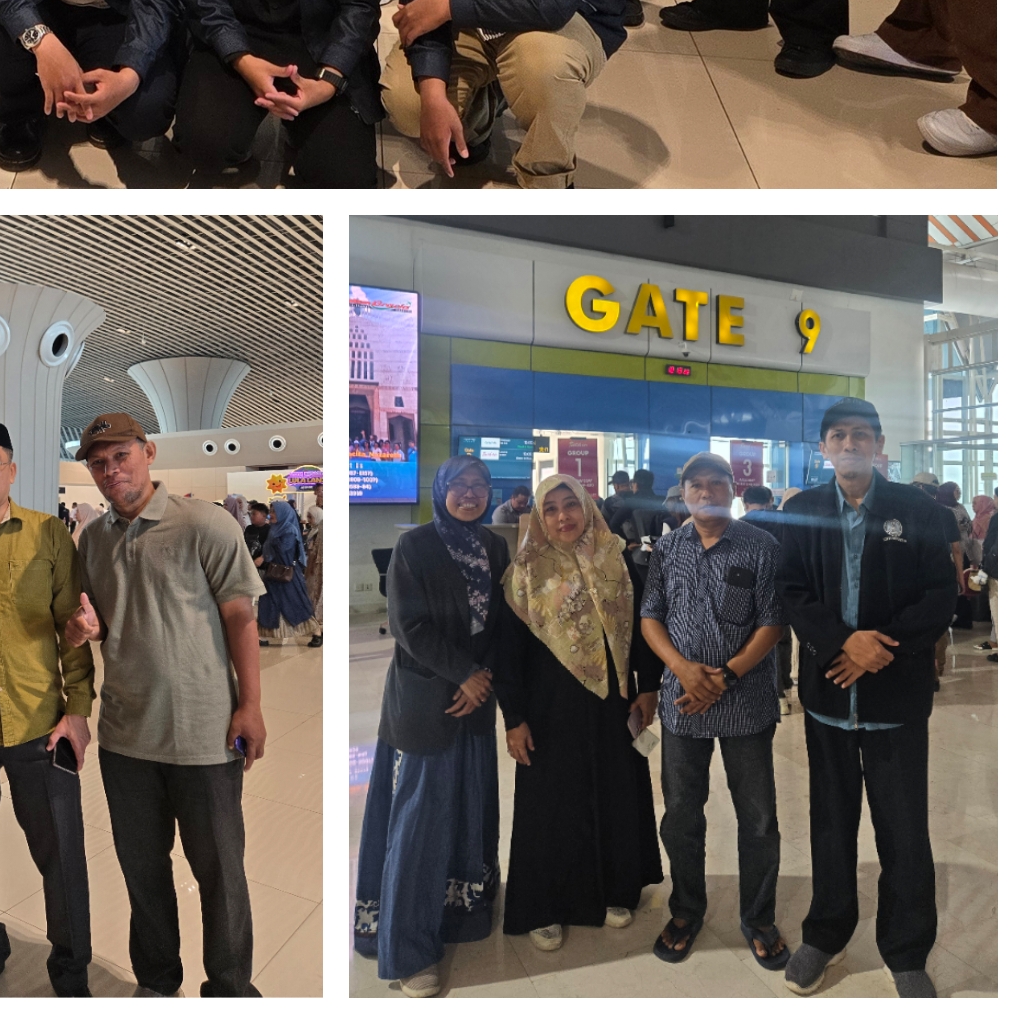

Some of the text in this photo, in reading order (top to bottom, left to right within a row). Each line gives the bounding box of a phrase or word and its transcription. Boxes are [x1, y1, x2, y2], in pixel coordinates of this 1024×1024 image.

[564, 274, 822, 354] GATE 9
[575, 458, 582, 477] 1
[743, 458, 752, 477] 3
